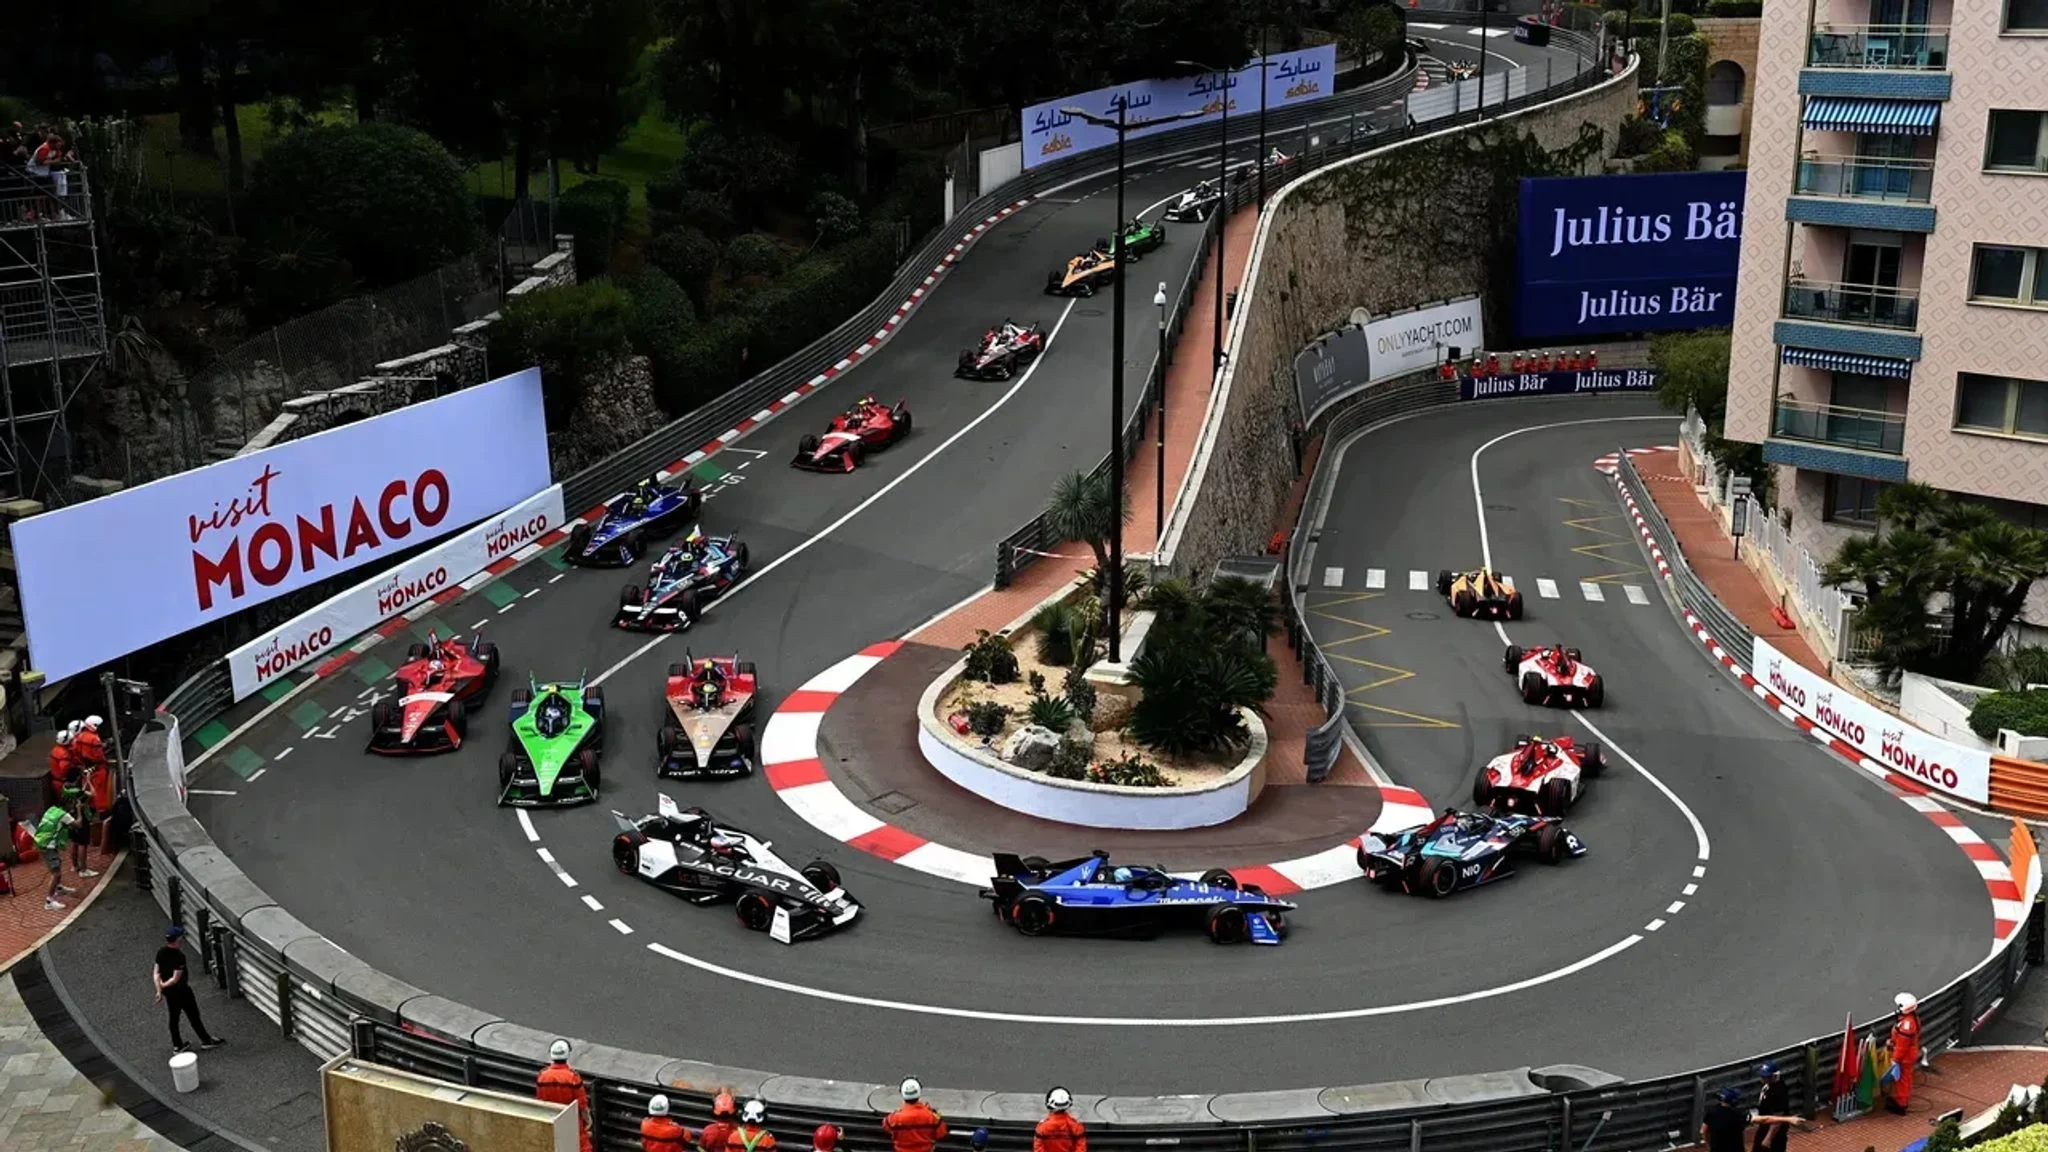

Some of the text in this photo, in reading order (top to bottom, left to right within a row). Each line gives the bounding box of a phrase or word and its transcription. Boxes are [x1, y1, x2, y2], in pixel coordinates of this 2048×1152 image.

[1550, 201, 1744, 257] Julius Bä
[1578, 286, 1723, 324] Julius Bär
[1473, 373, 1547, 398] Julius Bär
[1575, 370, 1657, 392] Julius Bär
[189, 463, 281, 543] visit
[193, 468, 450, 610] MONACO
[486, 520, 506, 540] visit
[487, 514, 548, 558] MONACO
[378, 574, 400, 598] visit
[379, 567, 447, 615] MONACO
[255, 636, 280, 662] visit
[256, 626, 333, 682] MONACO
[1769, 670, 1806, 707] MONACO
[1816, 703, 1865, 745] MONACO
[1882, 728, 1905, 743] visit
[1881, 741, 1958, 789] MONACO
[681, 860, 792, 891] JAGUAR
[1462, 863, 1481, 878] NIO
